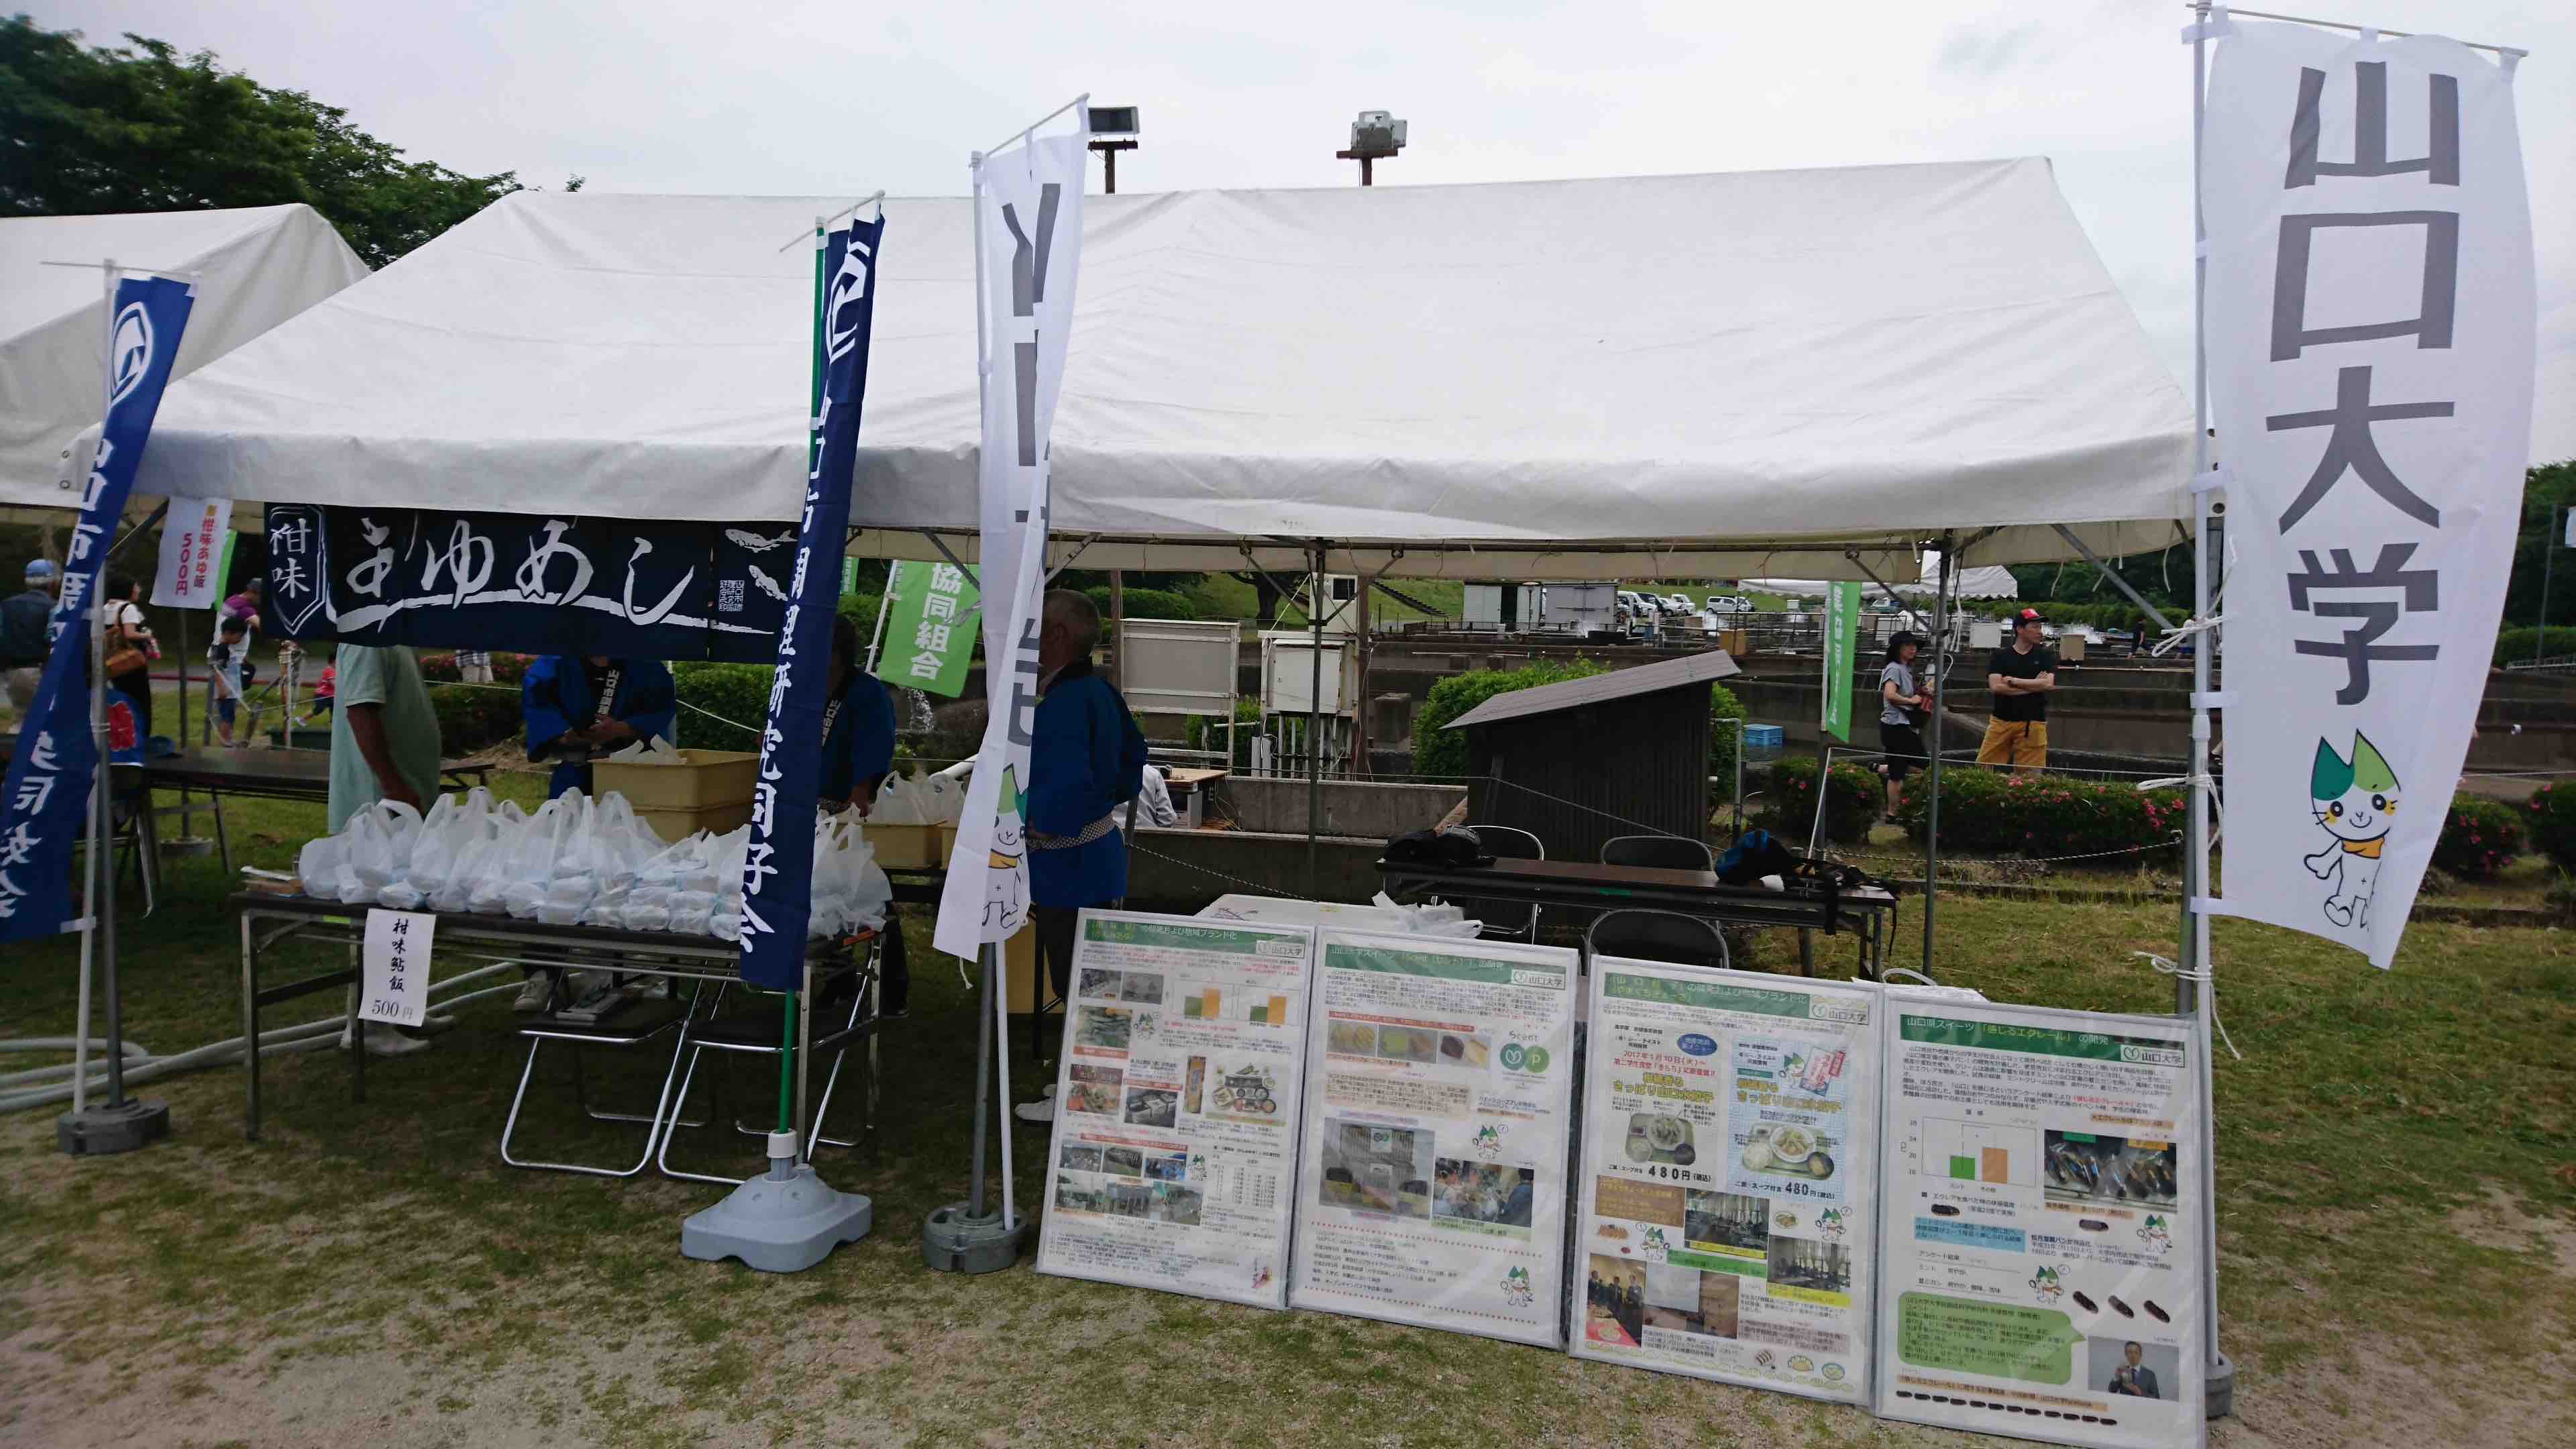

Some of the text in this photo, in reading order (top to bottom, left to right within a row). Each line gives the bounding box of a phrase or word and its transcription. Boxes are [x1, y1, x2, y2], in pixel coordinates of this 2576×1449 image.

[2265, 60, 2460, 705] 山口大学
[270, 518, 312, 599] 柑味
[346, 517, 696, 625] あゆめし
[389, 918, 409, 993] 柑味鮎飯
[372, 999, 413, 1020] 500円
[1829, 1010, 1867, 1023] 山口大学
[1509, 1030, 1540, 1042] Scent
[2142, 1053, 2181, 1063] 山口大学
